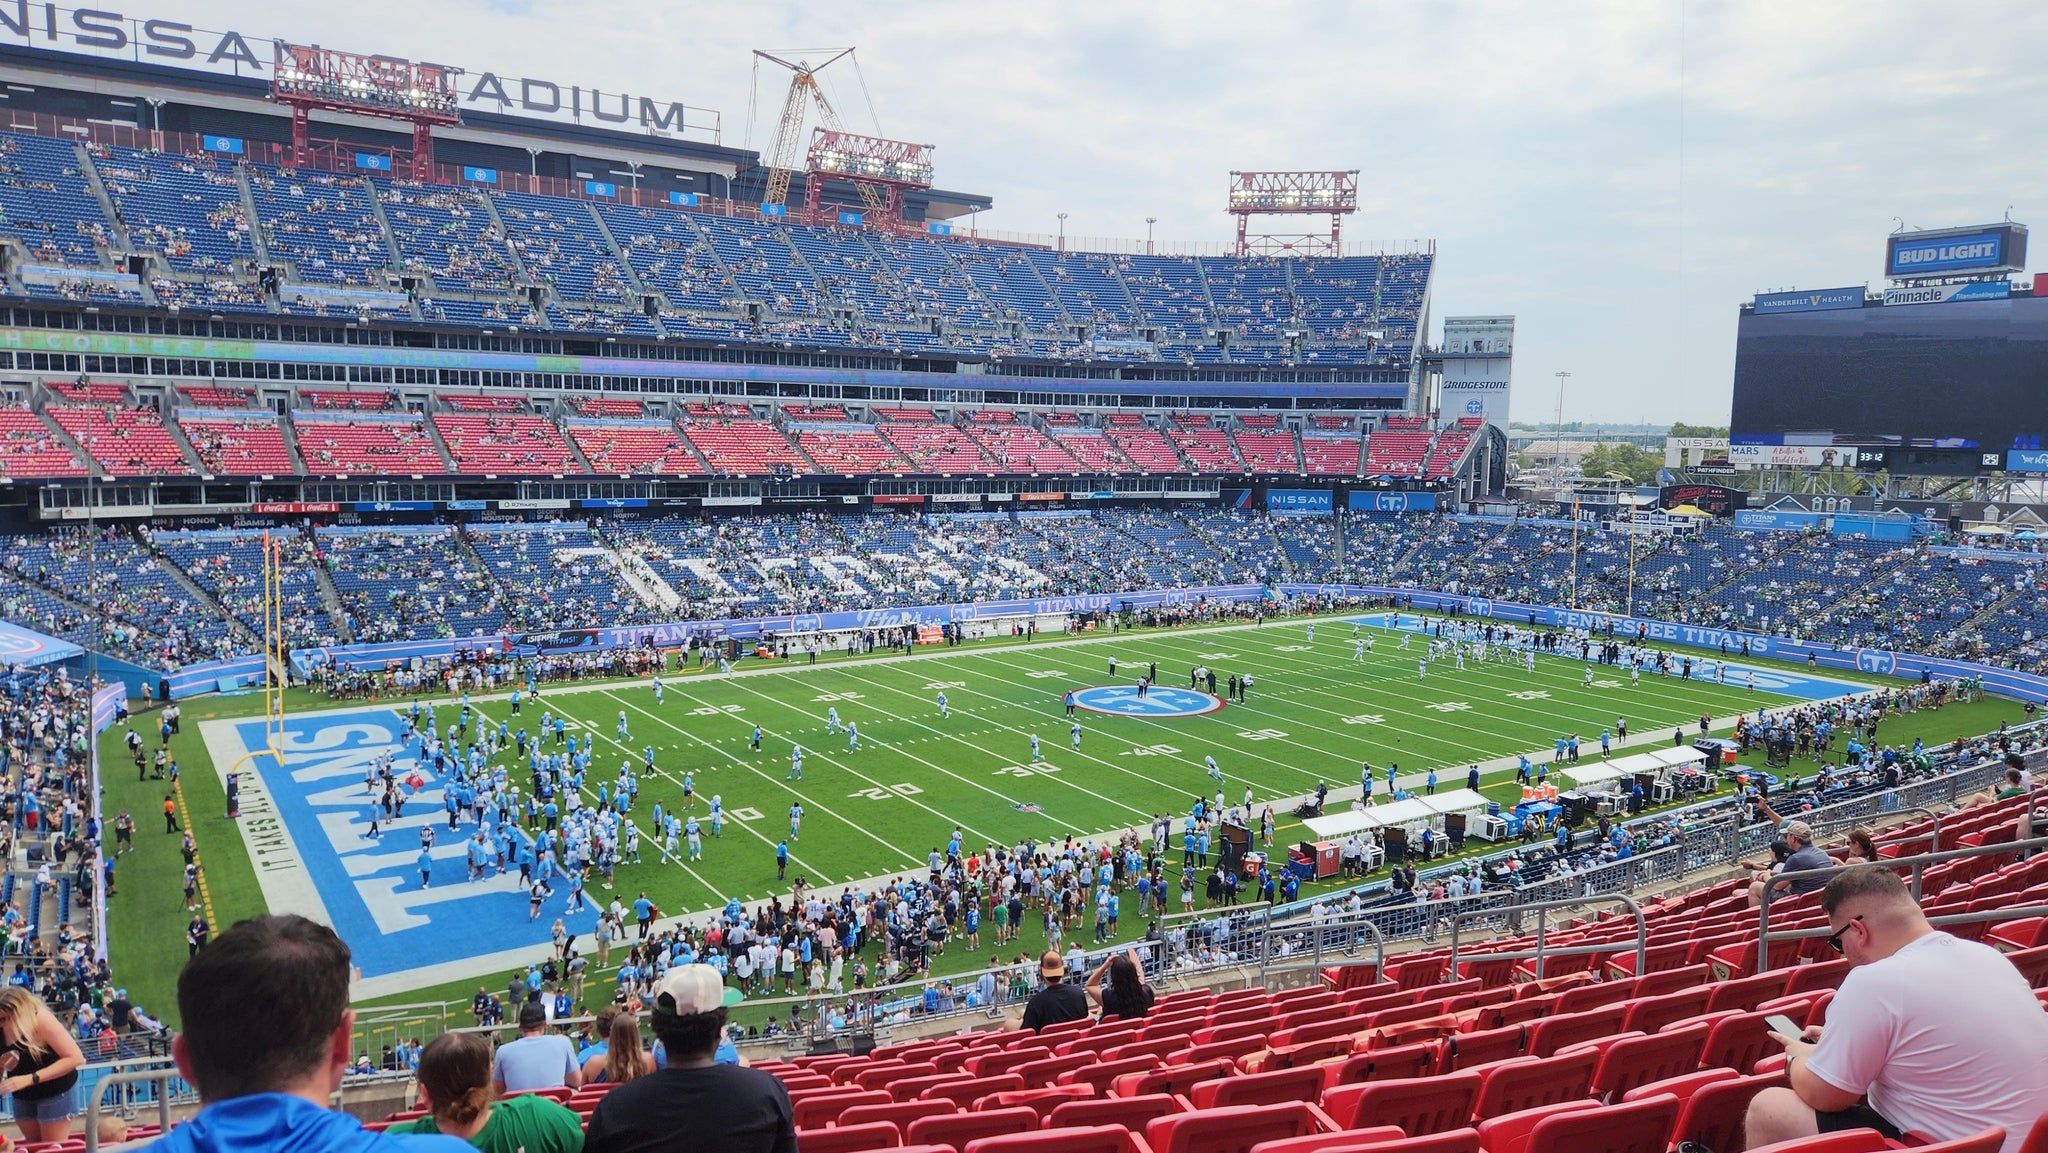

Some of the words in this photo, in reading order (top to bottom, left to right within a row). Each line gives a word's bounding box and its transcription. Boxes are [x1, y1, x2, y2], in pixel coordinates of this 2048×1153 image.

[1898, 249, 1937, 264] BUD
[1939, 243, 1994, 260] LIGHT
[1763, 298, 1808, 307] VANDERBILT
[1822, 295, 1853, 303] HEALTH
[1886, 288, 1942, 303] Pinnacle
[1443, 381, 1508, 389] BRIDGESTONE
[1731, 447, 1759, 455] MARS
[1860, 453, 1883, 462] 33:12
[1271, 496, 1329, 504] NISSAN
[263, 504, 286, 512] Coca-Cola
[183, 517, 216, 525] HONOR
[1035, 597, 1089, 613] TITAN
[1090, 597, 1112, 609] UP
[611, 626, 688, 645] TITAN
[1554, 611, 1677, 639] TENNESSEE
[1683, 625, 1769, 652] TITANS
[33, 652, 68, 663] NISSAN
[1237, 728, 1290, 741] 50
[1134, 744, 1182, 756] 40
[1000, 761, 1062, 778] 30
[856, 782, 924, 800] 20
[270, 723, 541, 936] TITANS
[246, 818, 288, 856] TAKES
[261, 859, 297, 872] IT
